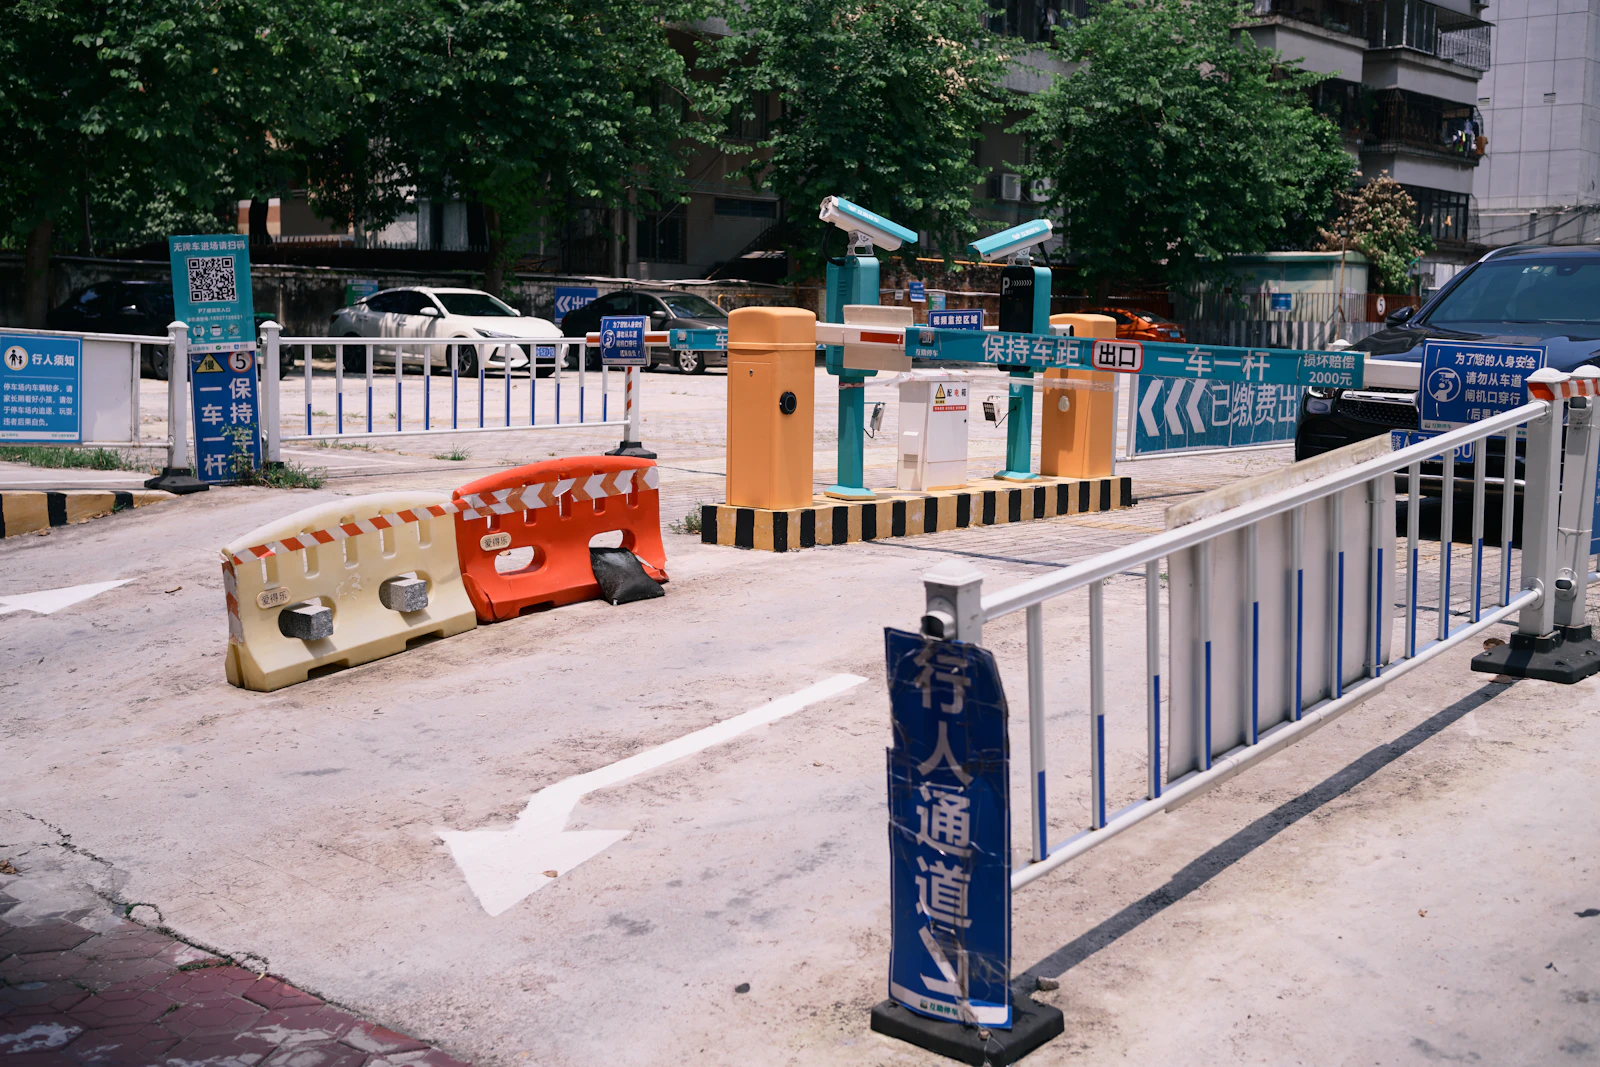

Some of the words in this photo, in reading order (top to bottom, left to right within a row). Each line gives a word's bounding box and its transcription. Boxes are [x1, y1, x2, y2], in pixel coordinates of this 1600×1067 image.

[174, 240, 246, 252] 无牌车进场请扫码
[1378, 299, 1384, 312] 5
[933, 315, 978, 325] 视频监控区域
[915, 348, 938, 358] 互助停车
[982, 334, 1080, 366] 保持车距
[1098, 344, 1136, 368] 出口
[32, 353, 75, 367] 行人须知
[204, 360, 214, 370] 慢
[235, 354, 246, 370] 5
[1157, 346, 1271, 382] 一车一杆
[1303, 353, 1355, 370] 损坏赔偿
[1455, 352, 1536, 370] 为了您的人身安全
[1308, 370, 1353, 386] 2000元
[1465, 372, 1522, 388] 请勿从车道
[1212, 382, 1306, 427] 已缴费出
[1464, 389, 1521, 406] 闸机口穿行
[200, 386, 227, 476] 一车一杆
[484, 535, 508, 548] 爱得乐
[260, 590, 288, 606] 爱得乐
[912, 648, 974, 928] 行人通道
[930, 1002, 958, 1016] 互助停车
